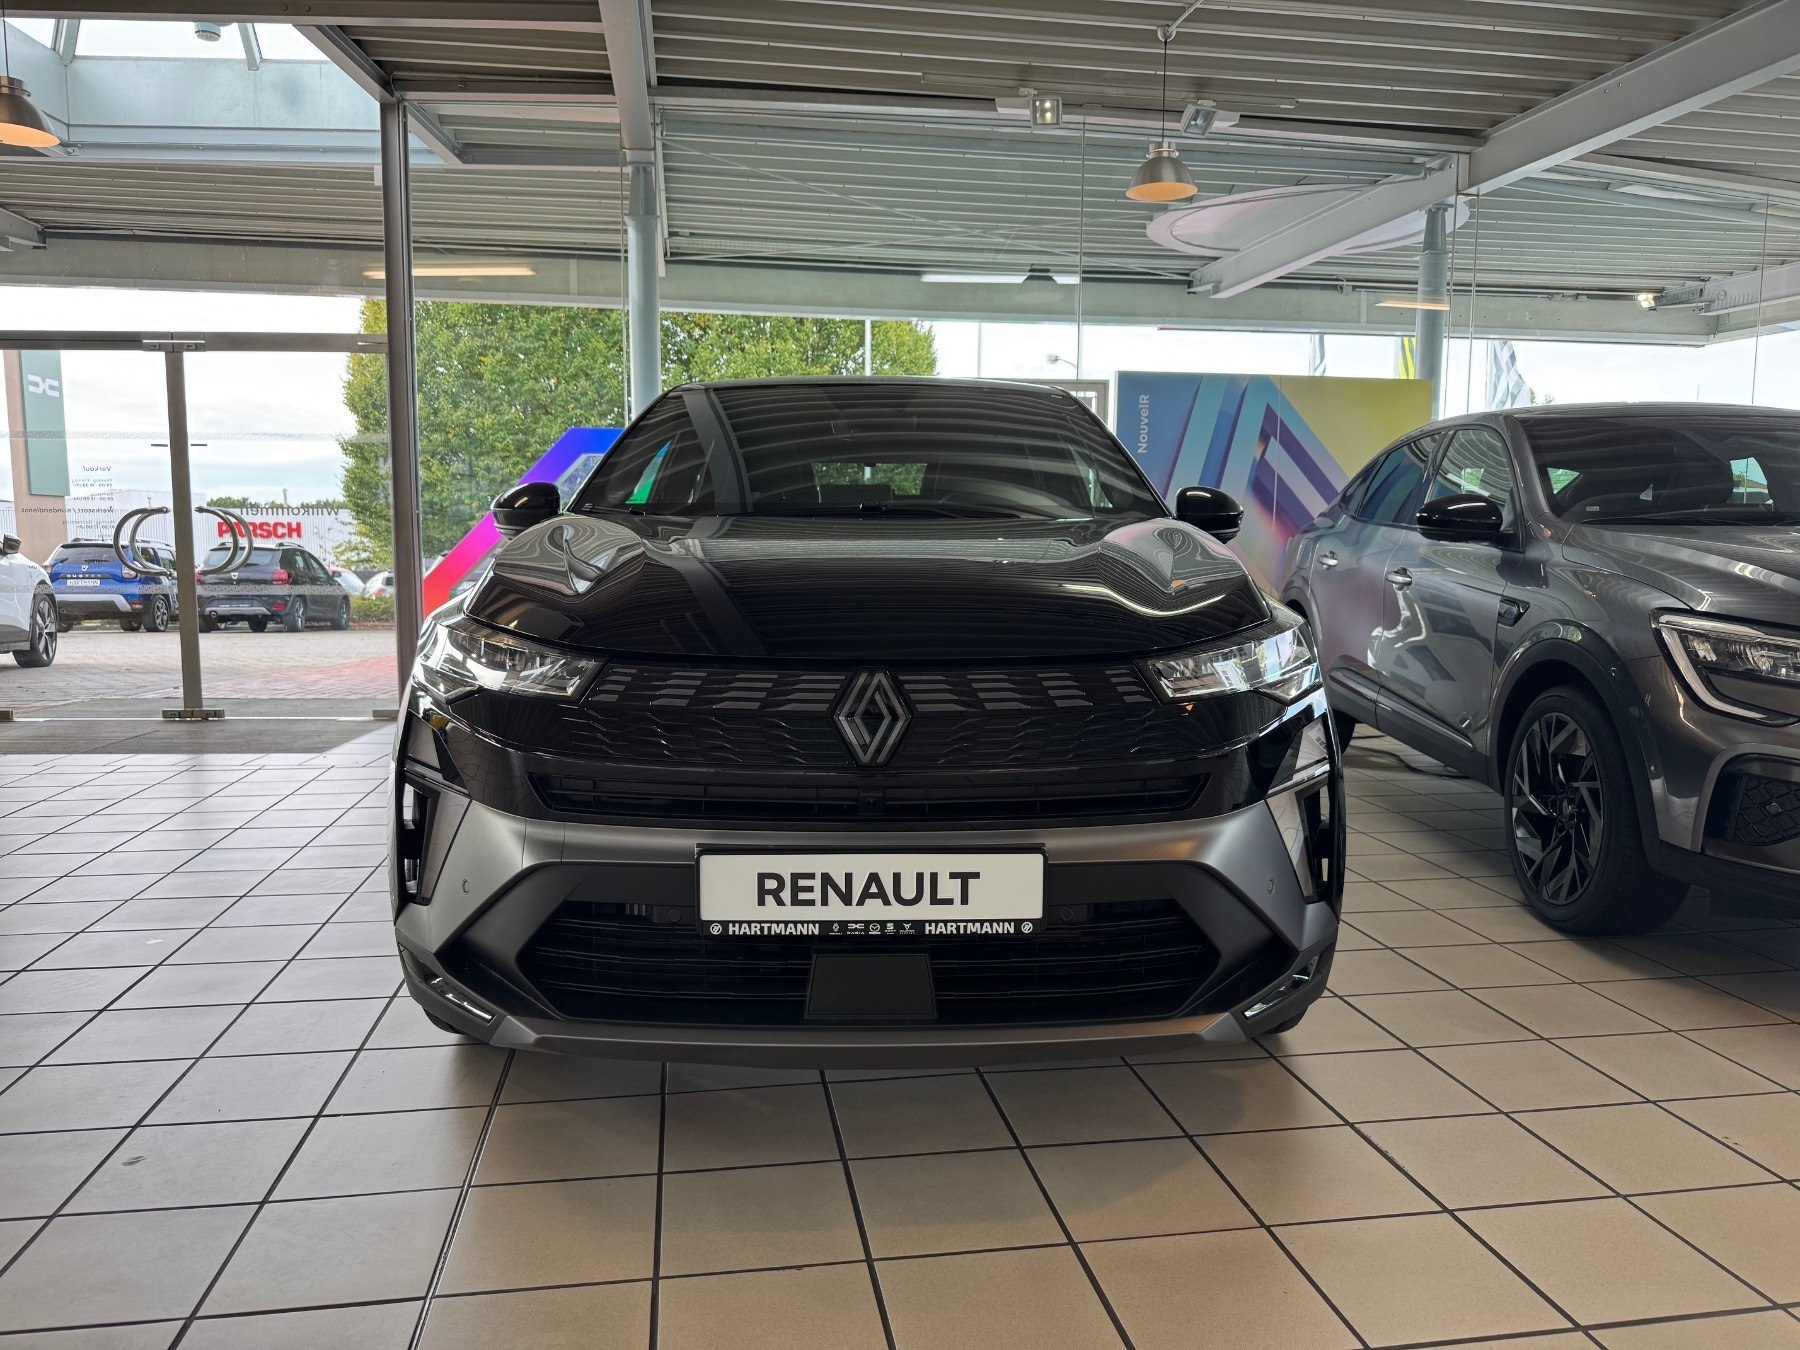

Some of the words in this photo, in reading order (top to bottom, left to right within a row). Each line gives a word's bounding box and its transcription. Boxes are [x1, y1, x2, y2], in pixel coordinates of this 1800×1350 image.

[1137, 394, 1150, 455] NouvelR
[756, 871, 981, 907] RENAULT
[728, 922, 820, 935] HARTMANN
[924, 921, 1015, 935] HARTMANN
